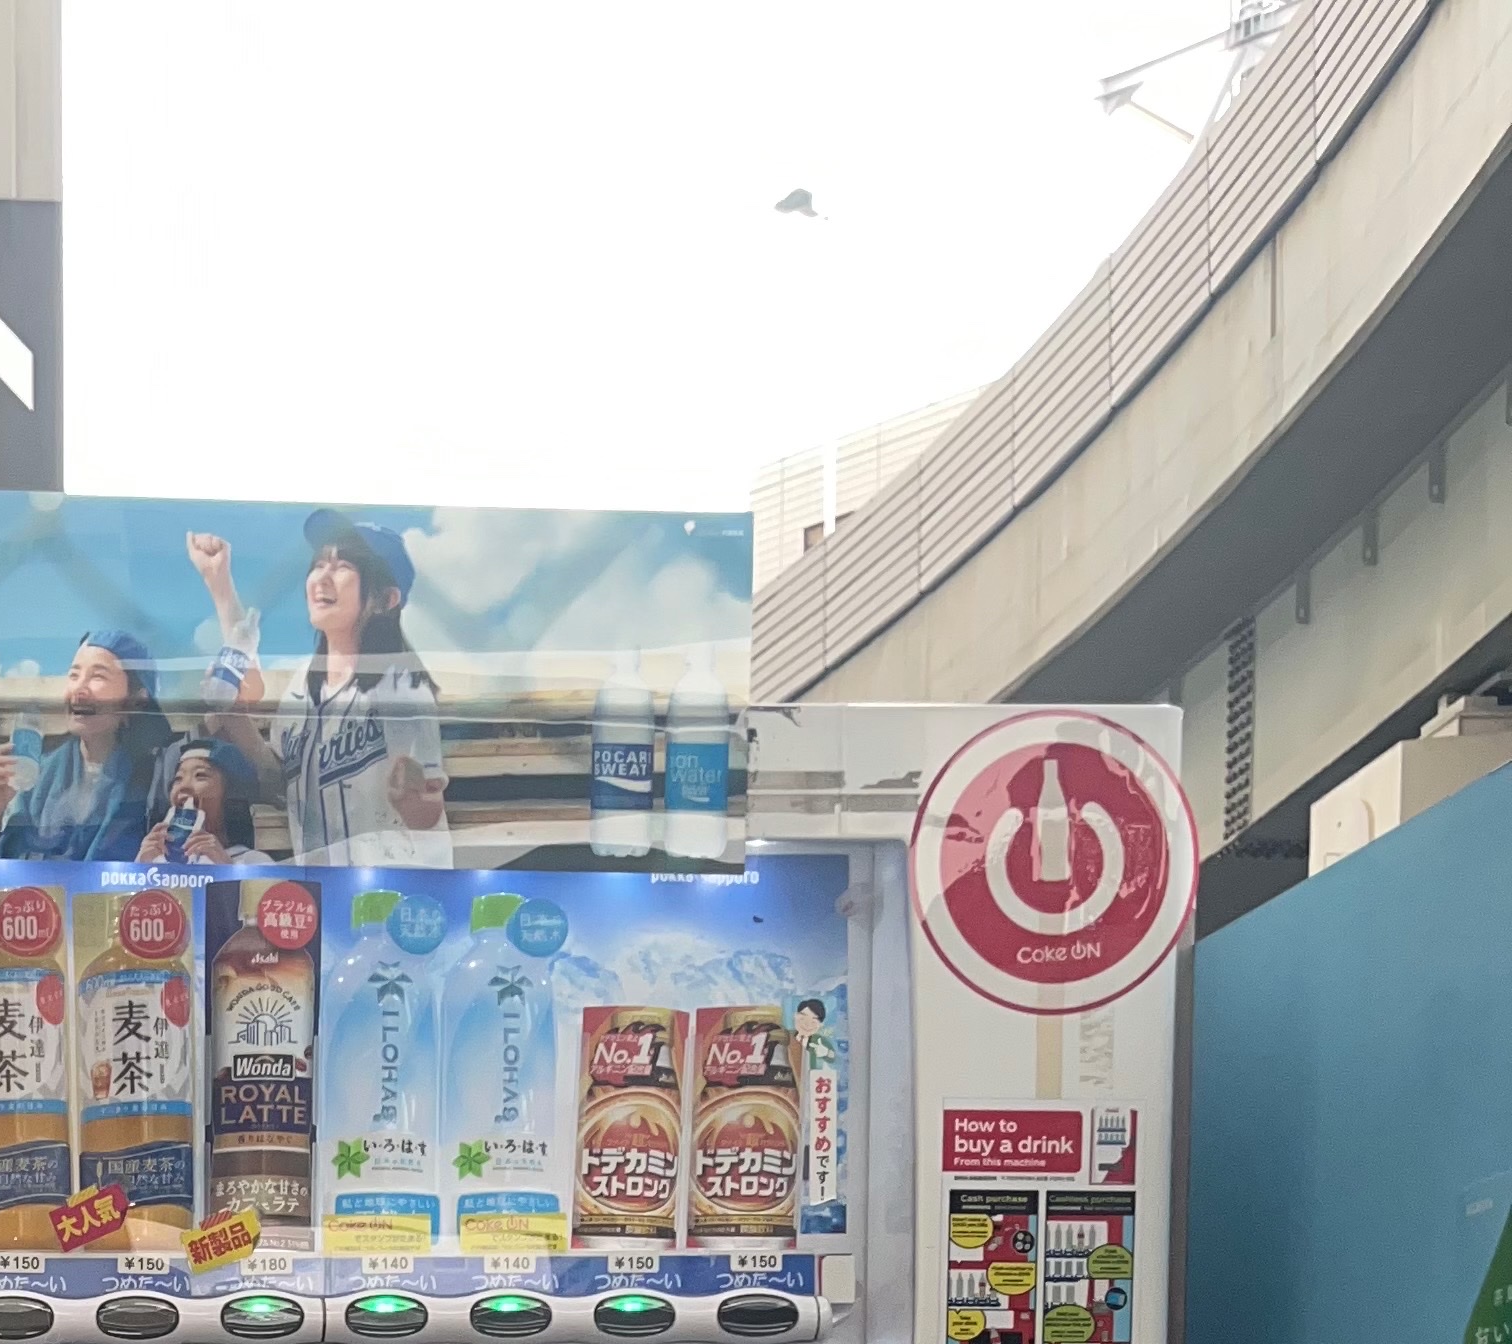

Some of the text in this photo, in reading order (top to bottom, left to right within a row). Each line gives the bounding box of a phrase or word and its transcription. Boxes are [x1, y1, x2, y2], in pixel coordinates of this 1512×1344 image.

[594, 751, 650, 765] POCARI
[594, 763, 647, 777] SWEAT
[2, 900, 46, 916] たっぷり
[1017, 941, 1101, 964] Coke ON
[112, 1001, 152, 1095] 麦茶
[594, 1032, 654, 1065] No.1
[235, 1058, 292, 1079] Wonda
[221, 1083, 305, 1104] ROYAL
[220, 1104, 306, 1124] LATTE
[954, 1118, 1017, 1133] How to
[954, 1136, 1073, 1155] buy a drink
[583, 1147, 676, 1174] ドデカミン
[696, 1147, 795, 1175] ドデカミン
[591, 1176, 671, 1197] ストロング
[705, 1176, 786, 1198] ストロング
[58, 1199, 120, 1242] 大人気
[187, 1224, 253, 1262] 新製品
[248, 1257, 287, 1271] ¥180
[368, 1257, 408, 1270] ¥140
